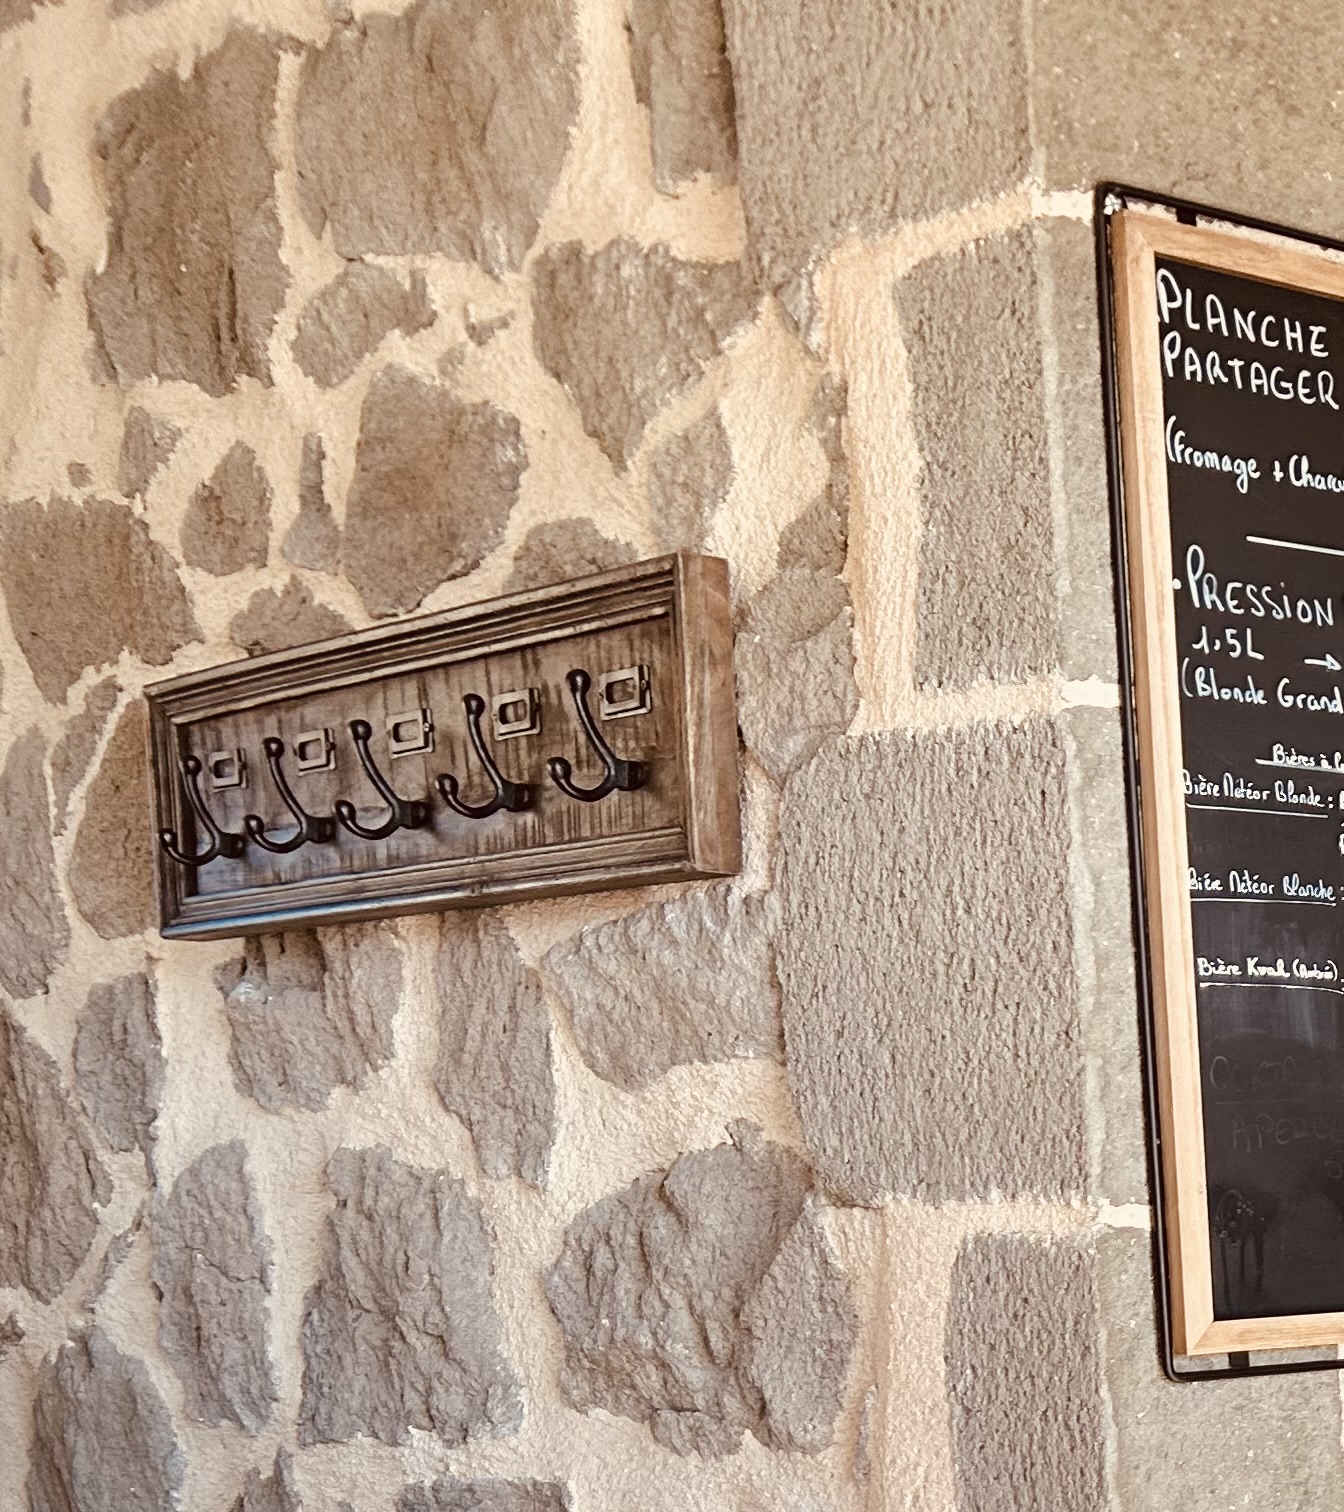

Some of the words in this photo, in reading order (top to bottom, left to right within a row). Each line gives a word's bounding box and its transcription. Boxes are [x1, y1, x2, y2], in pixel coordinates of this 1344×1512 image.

[1156, 268, 1328, 357] PLANCHE
[1181, 657, 1268, 704] (Blonde
[1277, 677, 1344, 715] Grand
